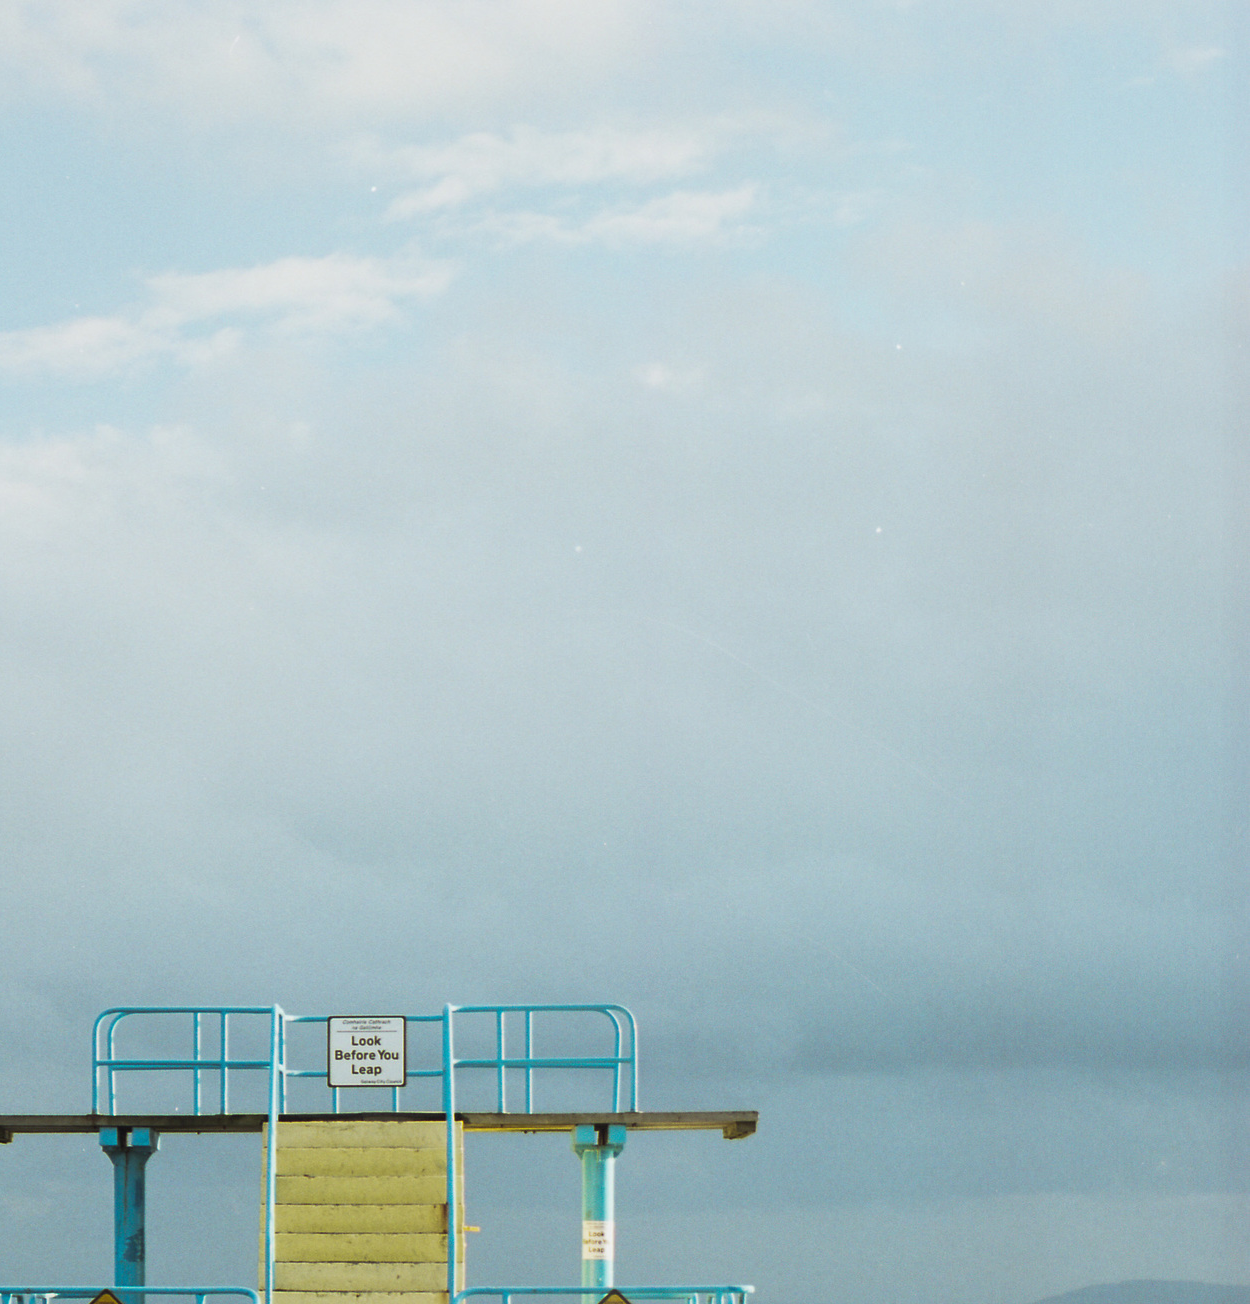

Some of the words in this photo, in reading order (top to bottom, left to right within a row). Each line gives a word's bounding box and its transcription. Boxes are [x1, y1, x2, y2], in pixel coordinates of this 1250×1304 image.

[351, 1035, 381, 1046] Look
[335, 1049, 376, 1060] Before
[377, 1049, 399, 1060] You
[351, 1064, 382, 1076] Leap
